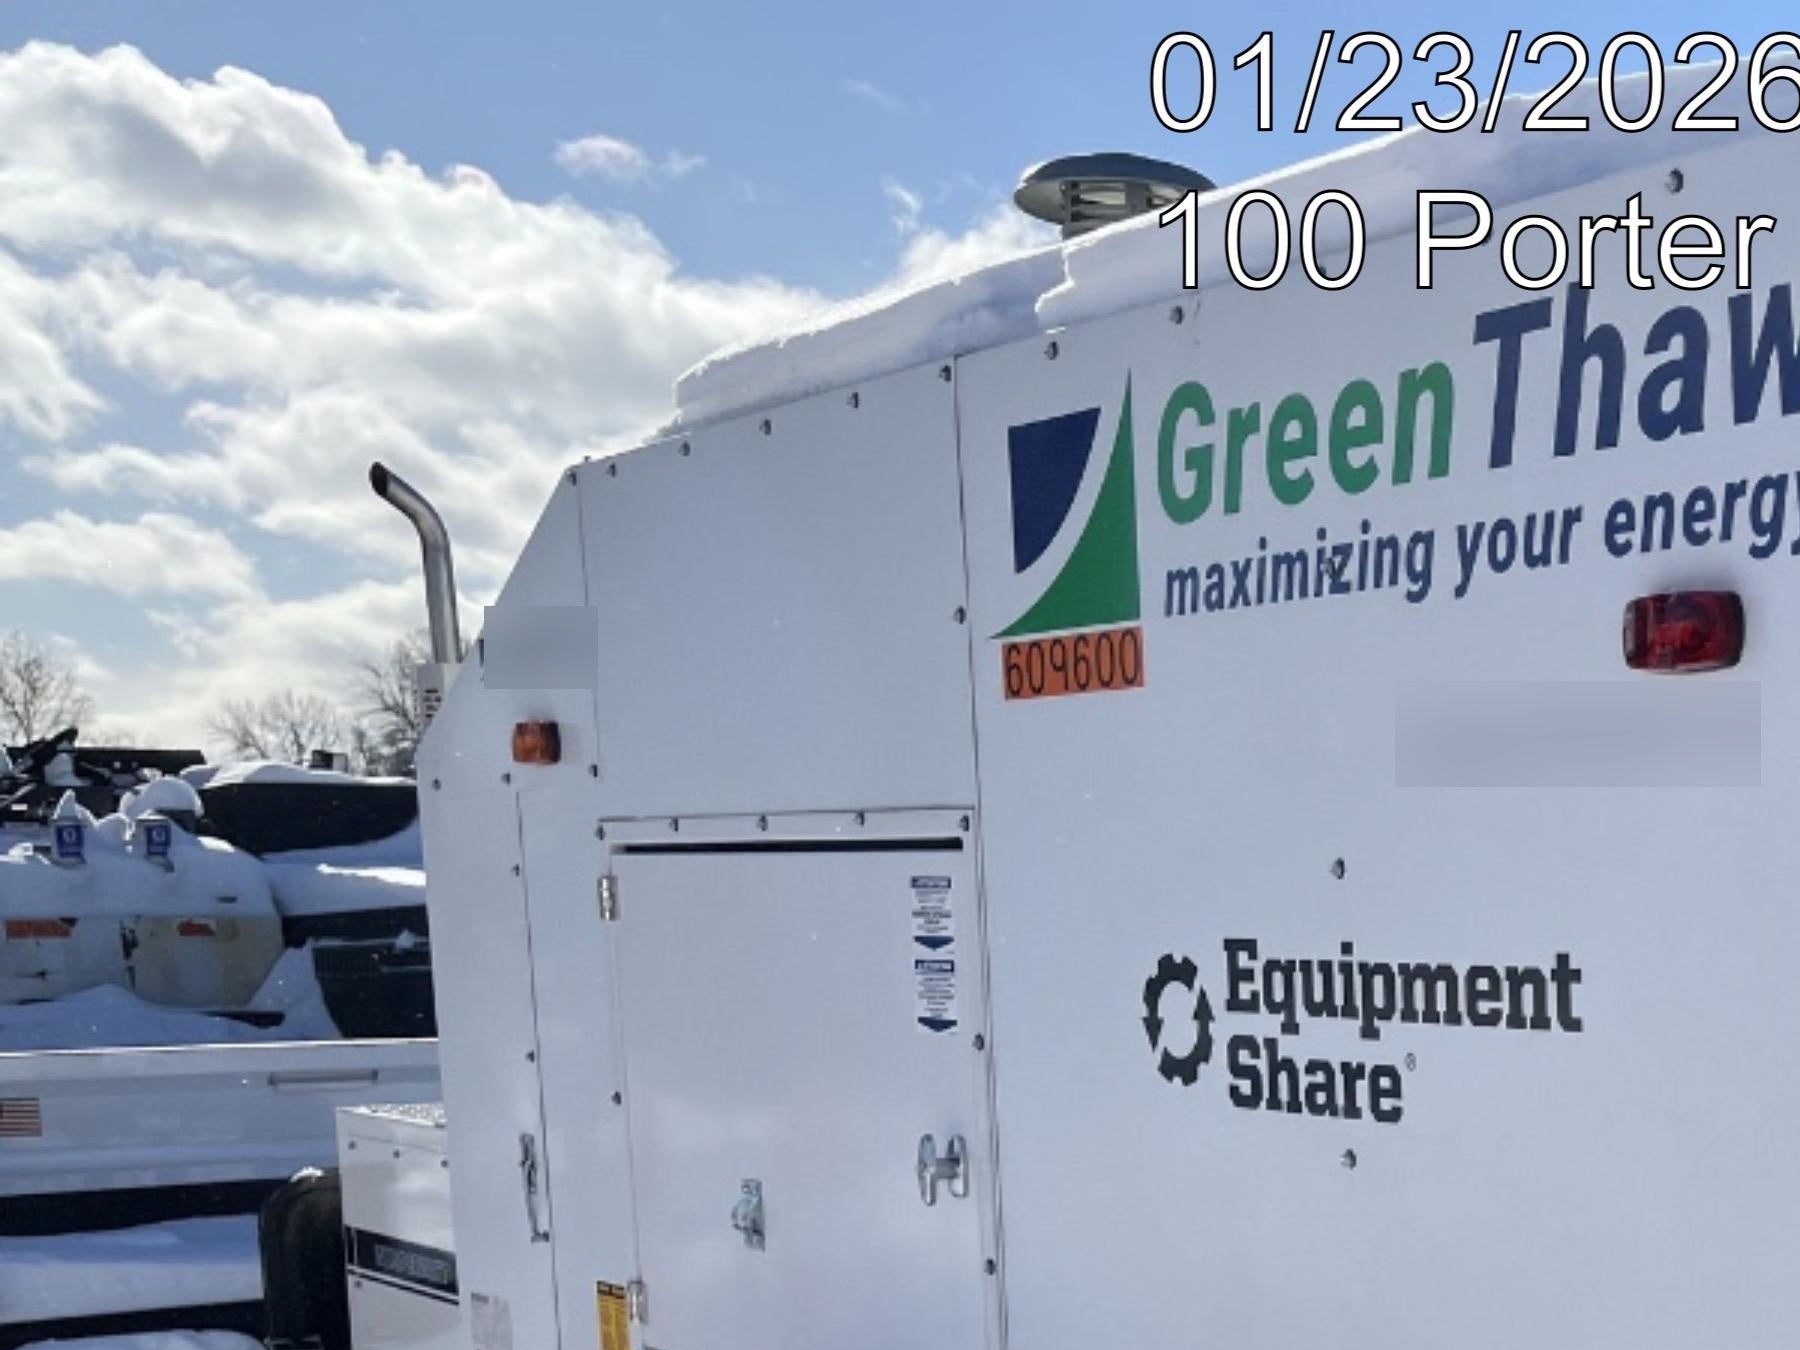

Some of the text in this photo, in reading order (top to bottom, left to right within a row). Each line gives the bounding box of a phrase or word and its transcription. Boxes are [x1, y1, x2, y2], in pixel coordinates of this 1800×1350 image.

[1163, 520, 1436, 618] maximizing
[1455, 506, 1584, 597] your
[1007, 629, 1138, 697] 609600
[1223, 938, 1584, 1040] Equipment
